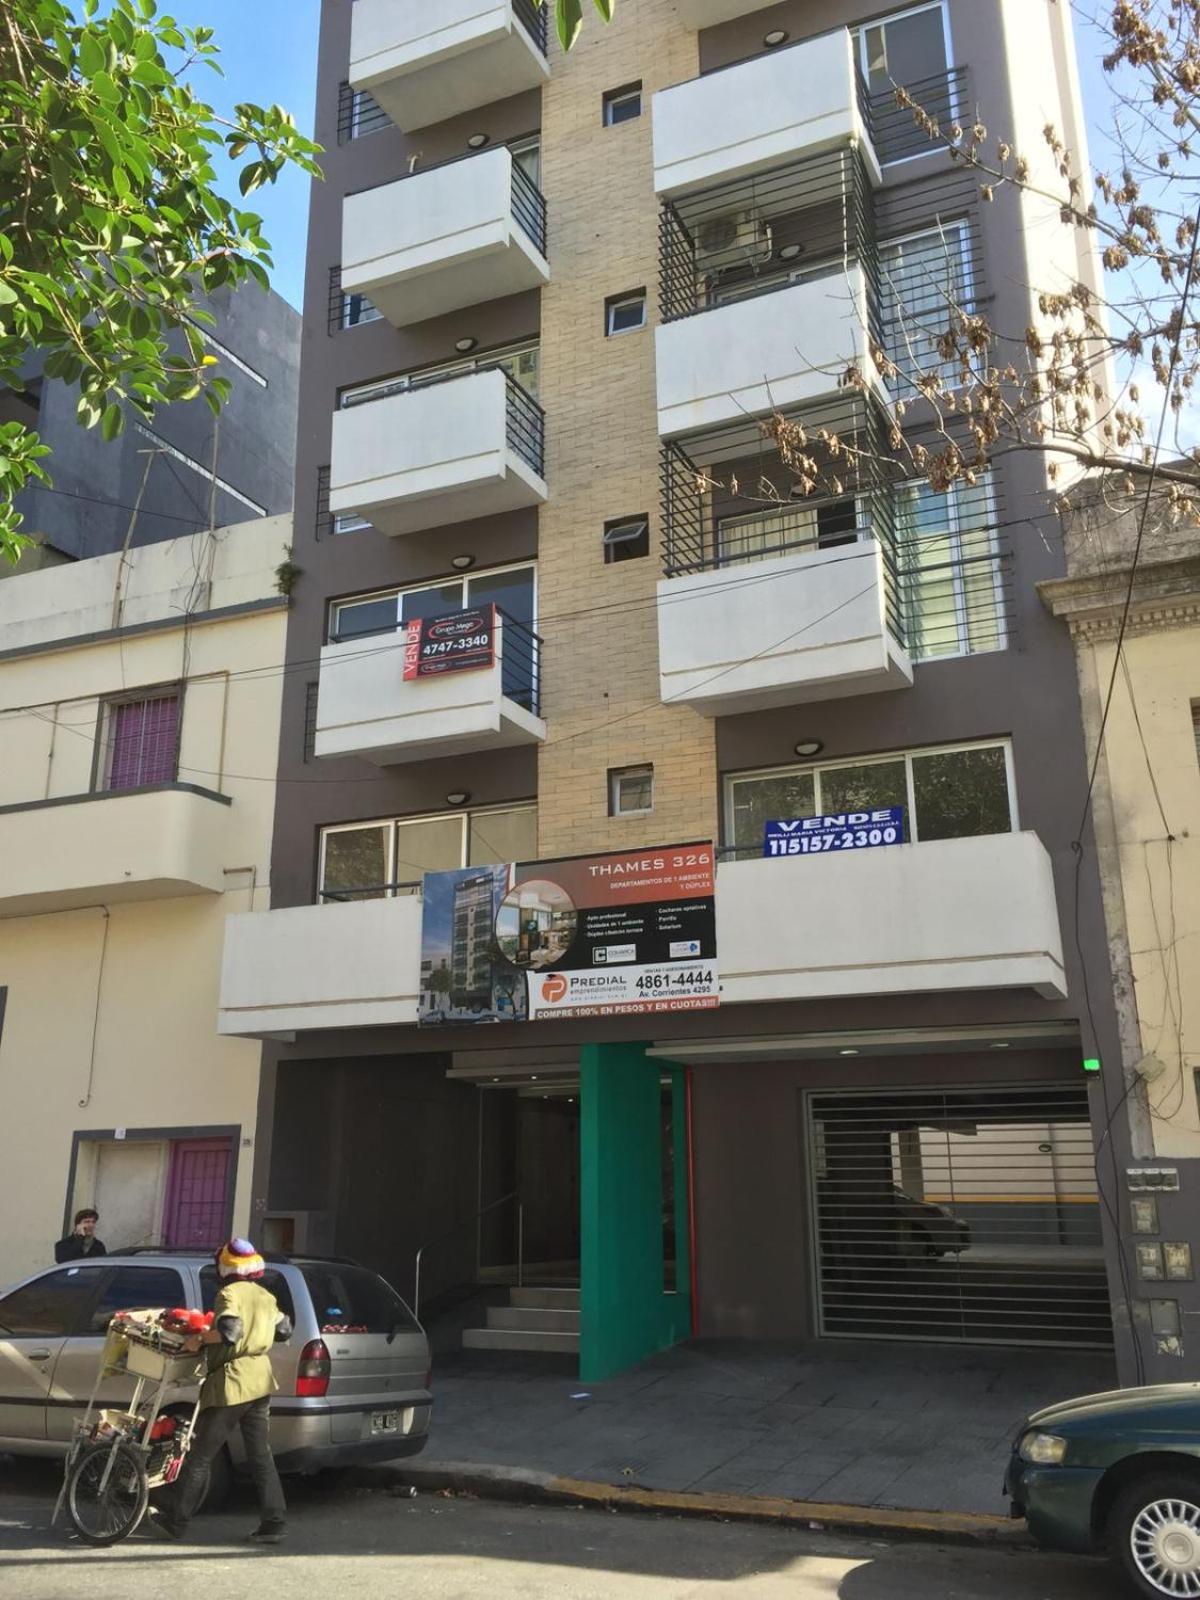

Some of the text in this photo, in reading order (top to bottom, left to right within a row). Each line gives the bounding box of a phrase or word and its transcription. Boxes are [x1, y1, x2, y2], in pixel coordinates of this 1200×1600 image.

[404, 625, 420, 673] VENDE
[423, 635, 489, 655] 4747-3340
[778, 809, 892, 832] VENDE
[769, 827, 897, 855] 115157-2300
[588, 853, 710, 877] THAMES 326
[610, 878, 663, 889] DEPARTAMENTOS
[678, 873, 710, 882] AMBIENTE
[570, 976, 627, 988] PREDIAL
[636, 970, 713, 989] 4861-4444
[652, 988, 691, 997] Corrientes
[693, 985, 711, 993] 4295
[537, 1009, 573, 1019] COMPRE
[575, 1007, 598, 1017] 100%
[600, 1005, 613, 1014] EN
[615, 1003, 645, 1013] PESOS
[647, 1003, 652, 1011] Y
[655, 1001, 668, 1010] EN
